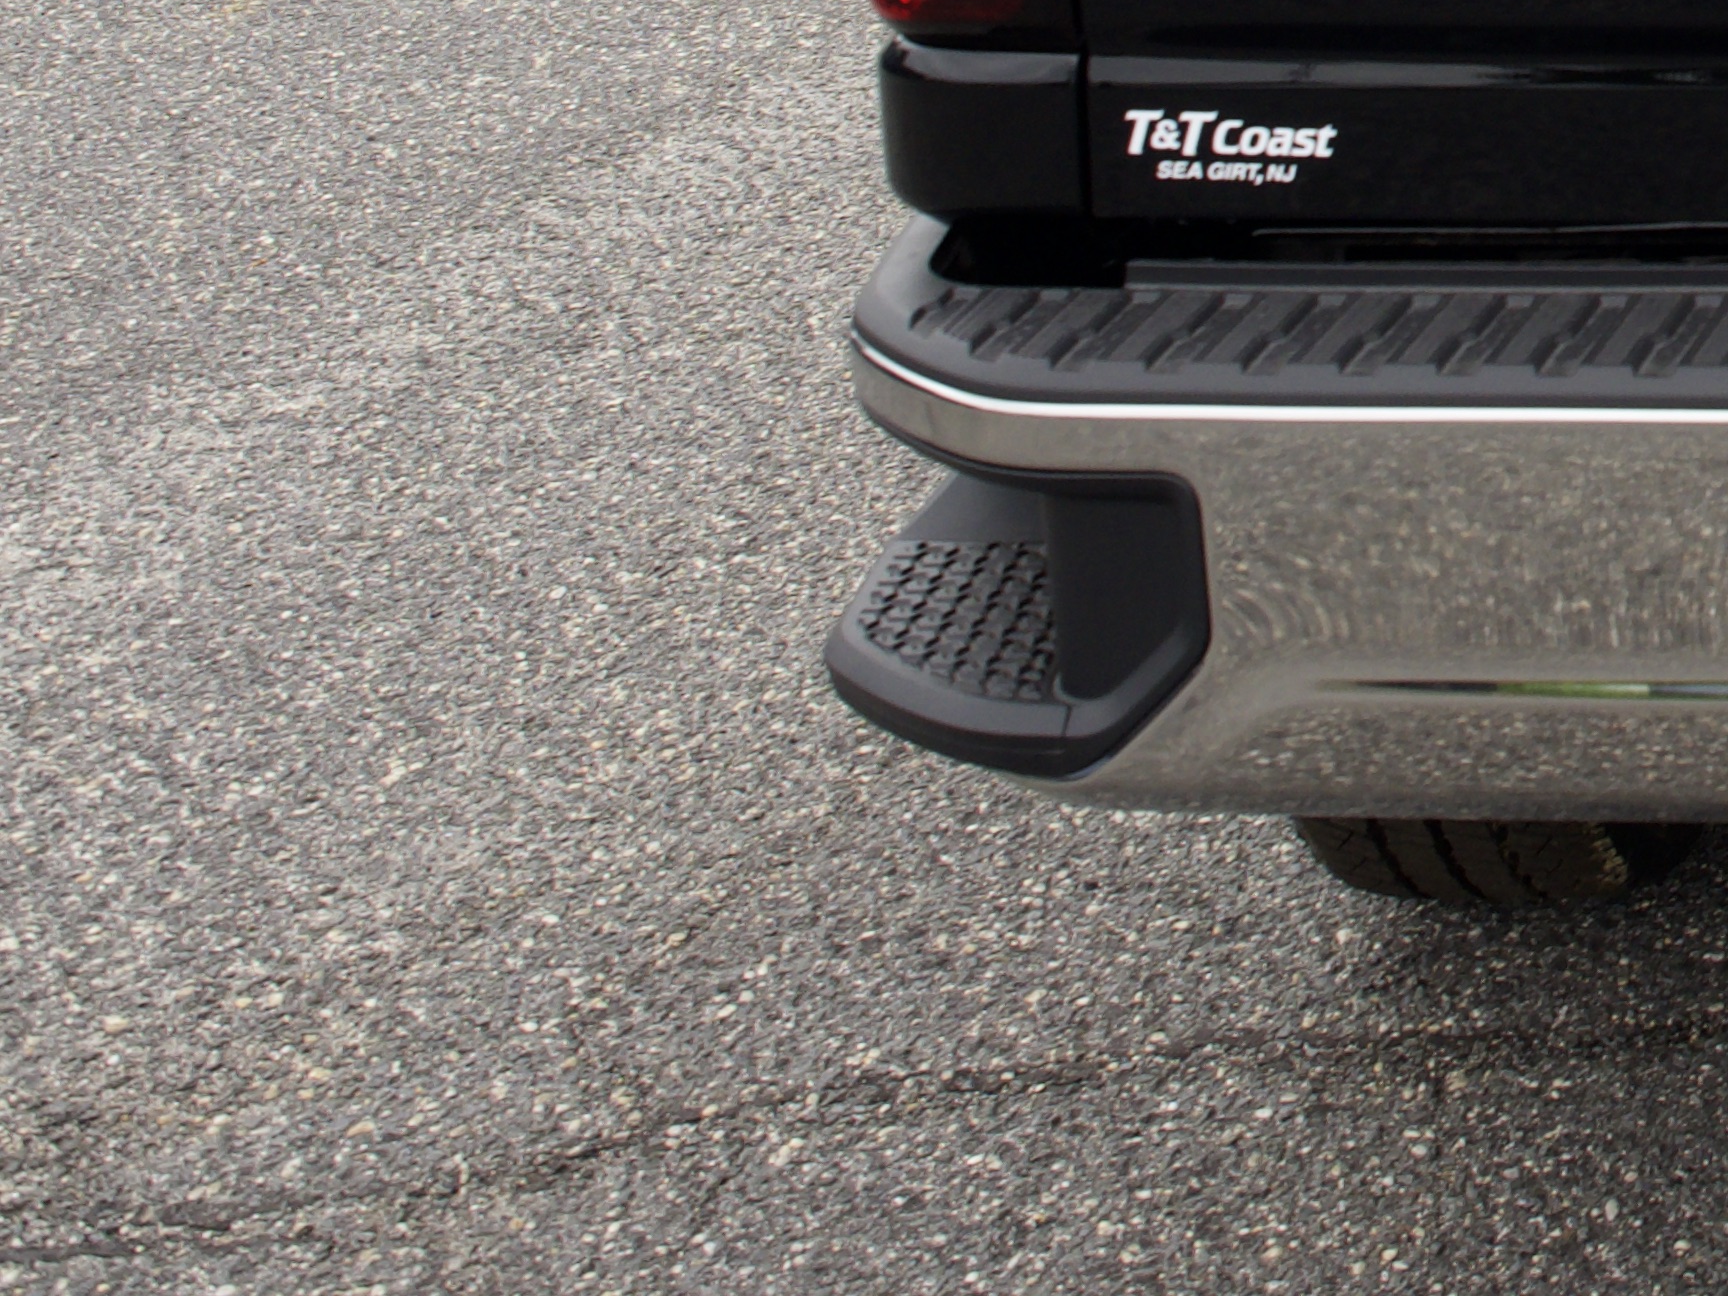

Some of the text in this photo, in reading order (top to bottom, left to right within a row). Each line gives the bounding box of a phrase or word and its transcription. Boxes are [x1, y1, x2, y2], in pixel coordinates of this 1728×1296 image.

[1124, 108, 1338, 158] T&T Coast
[1155, 160, 1203, 180] SEA
